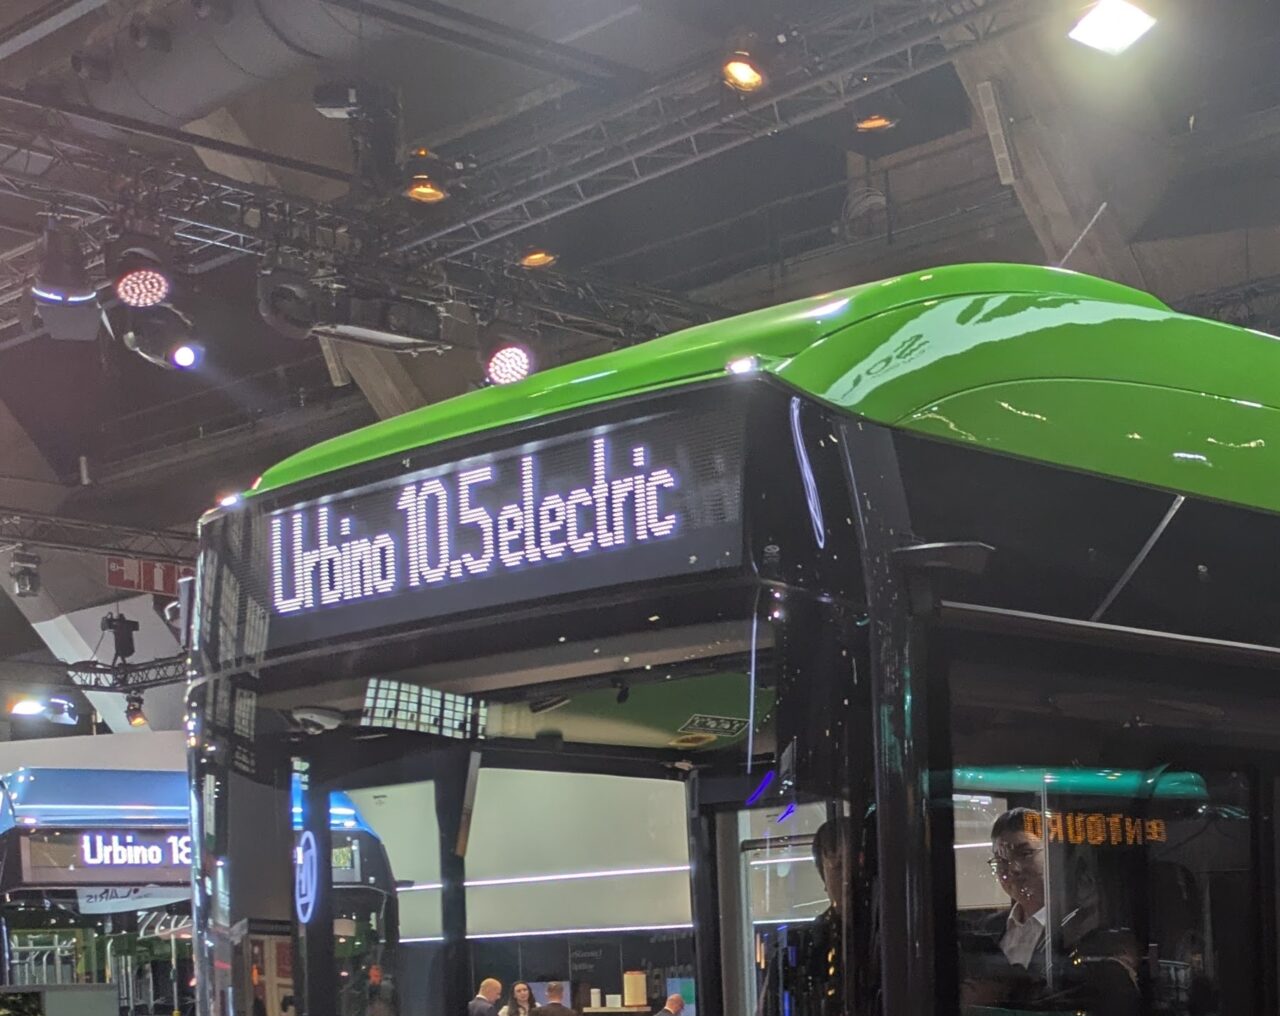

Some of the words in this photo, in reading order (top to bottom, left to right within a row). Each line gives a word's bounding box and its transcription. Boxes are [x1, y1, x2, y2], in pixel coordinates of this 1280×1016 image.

[271, 506, 396, 614] Urbino
[82, 834, 162, 865] Urbino
[166, 835, 193, 865] 18
